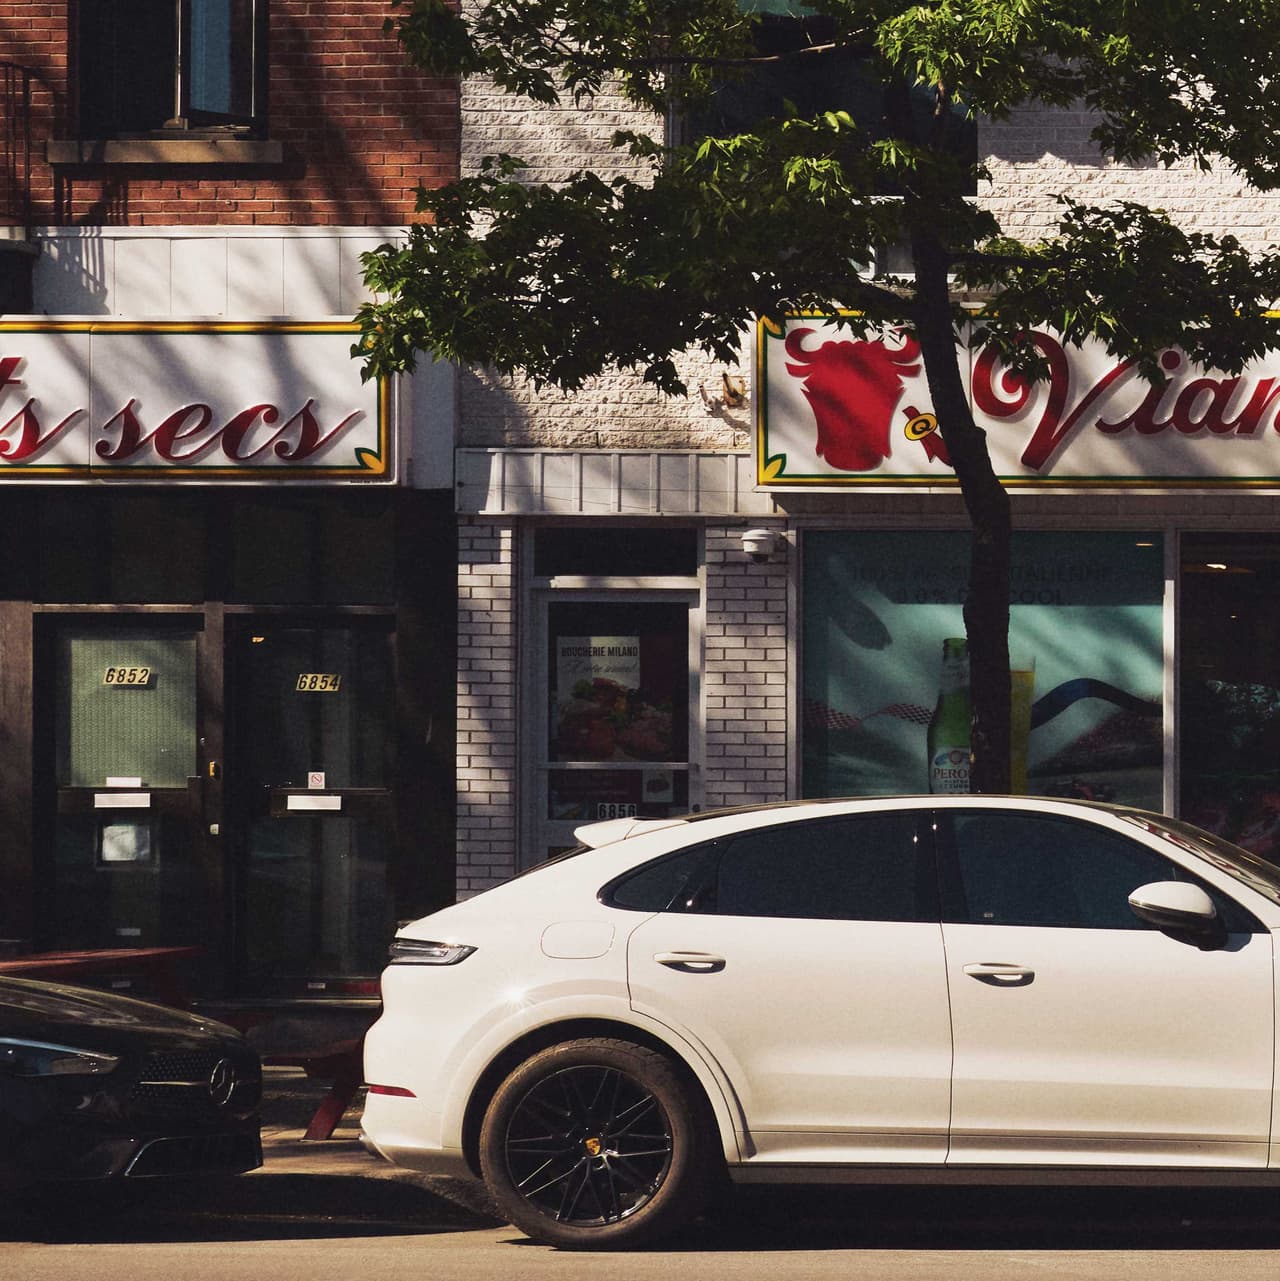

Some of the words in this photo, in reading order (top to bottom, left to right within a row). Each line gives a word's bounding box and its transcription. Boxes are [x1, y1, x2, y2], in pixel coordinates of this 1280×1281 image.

[95, 398, 362, 461] secs
[608, 646, 639, 657] MILANO
[105, 668, 149, 684] 6852
[298, 675, 339, 690] 6854
[933, 767, 970, 779] PERO
